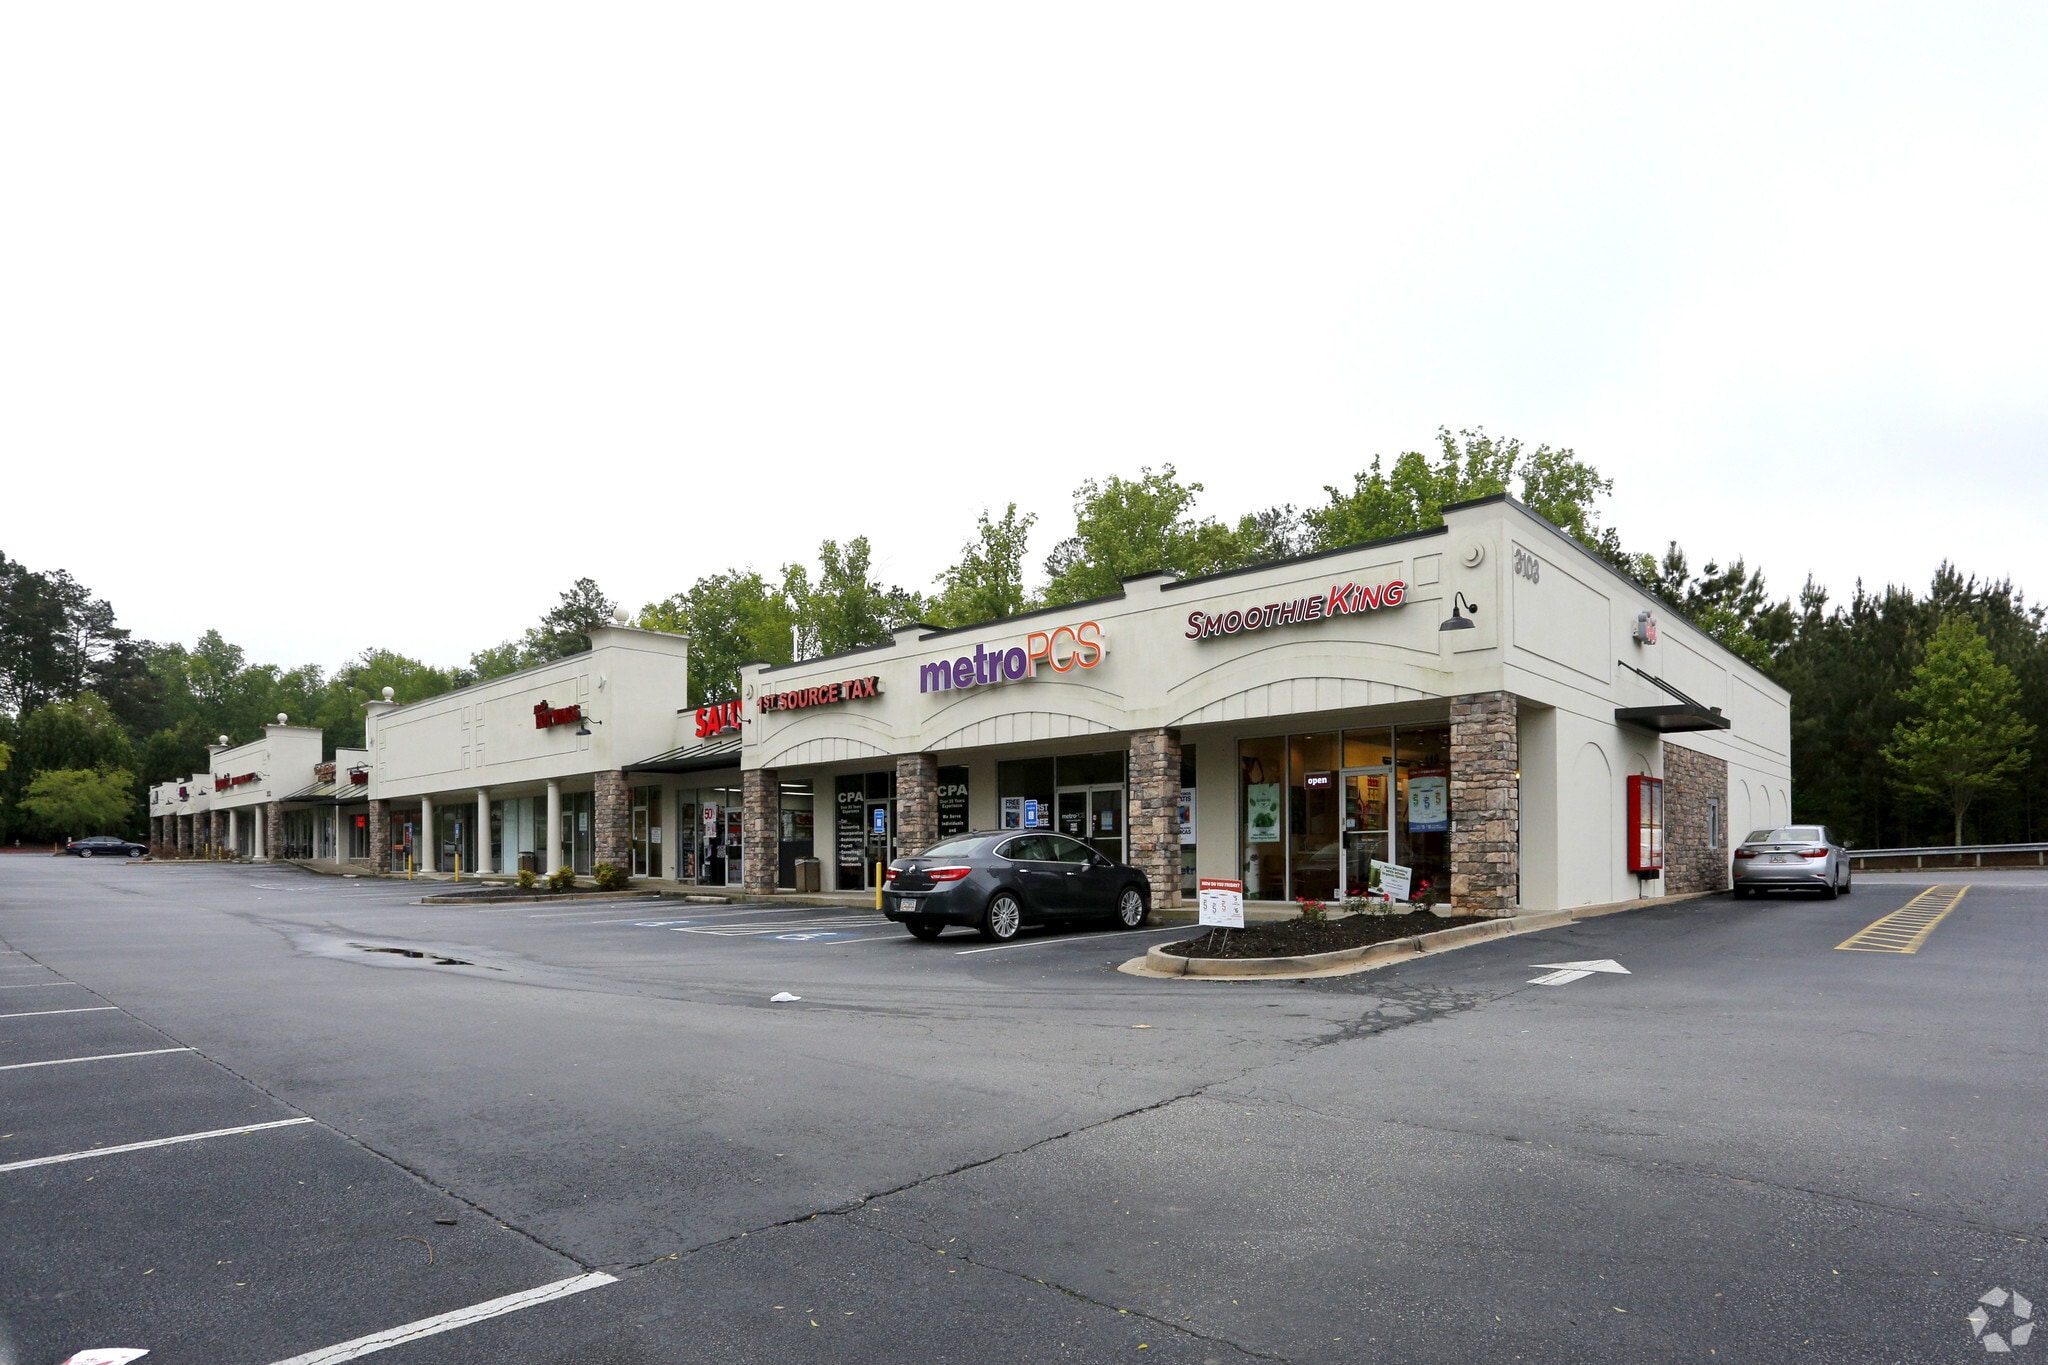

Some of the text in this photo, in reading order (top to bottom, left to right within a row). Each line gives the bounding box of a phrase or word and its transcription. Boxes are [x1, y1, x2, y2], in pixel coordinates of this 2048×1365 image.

[1514, 548, 1540, 584] 3103
[1184, 594, 1324, 641] SMOOTHIE
[920, 620, 1105, 694] metroPCS
[777, 682, 840, 712] SOURCE
[841, 676, 879, 701] TAX
[937, 784, 968, 797] CPA
[1307, 777, 1328, 786] open
[838, 792, 864, 803] CPA
[705, 808, 713, 819] 50
